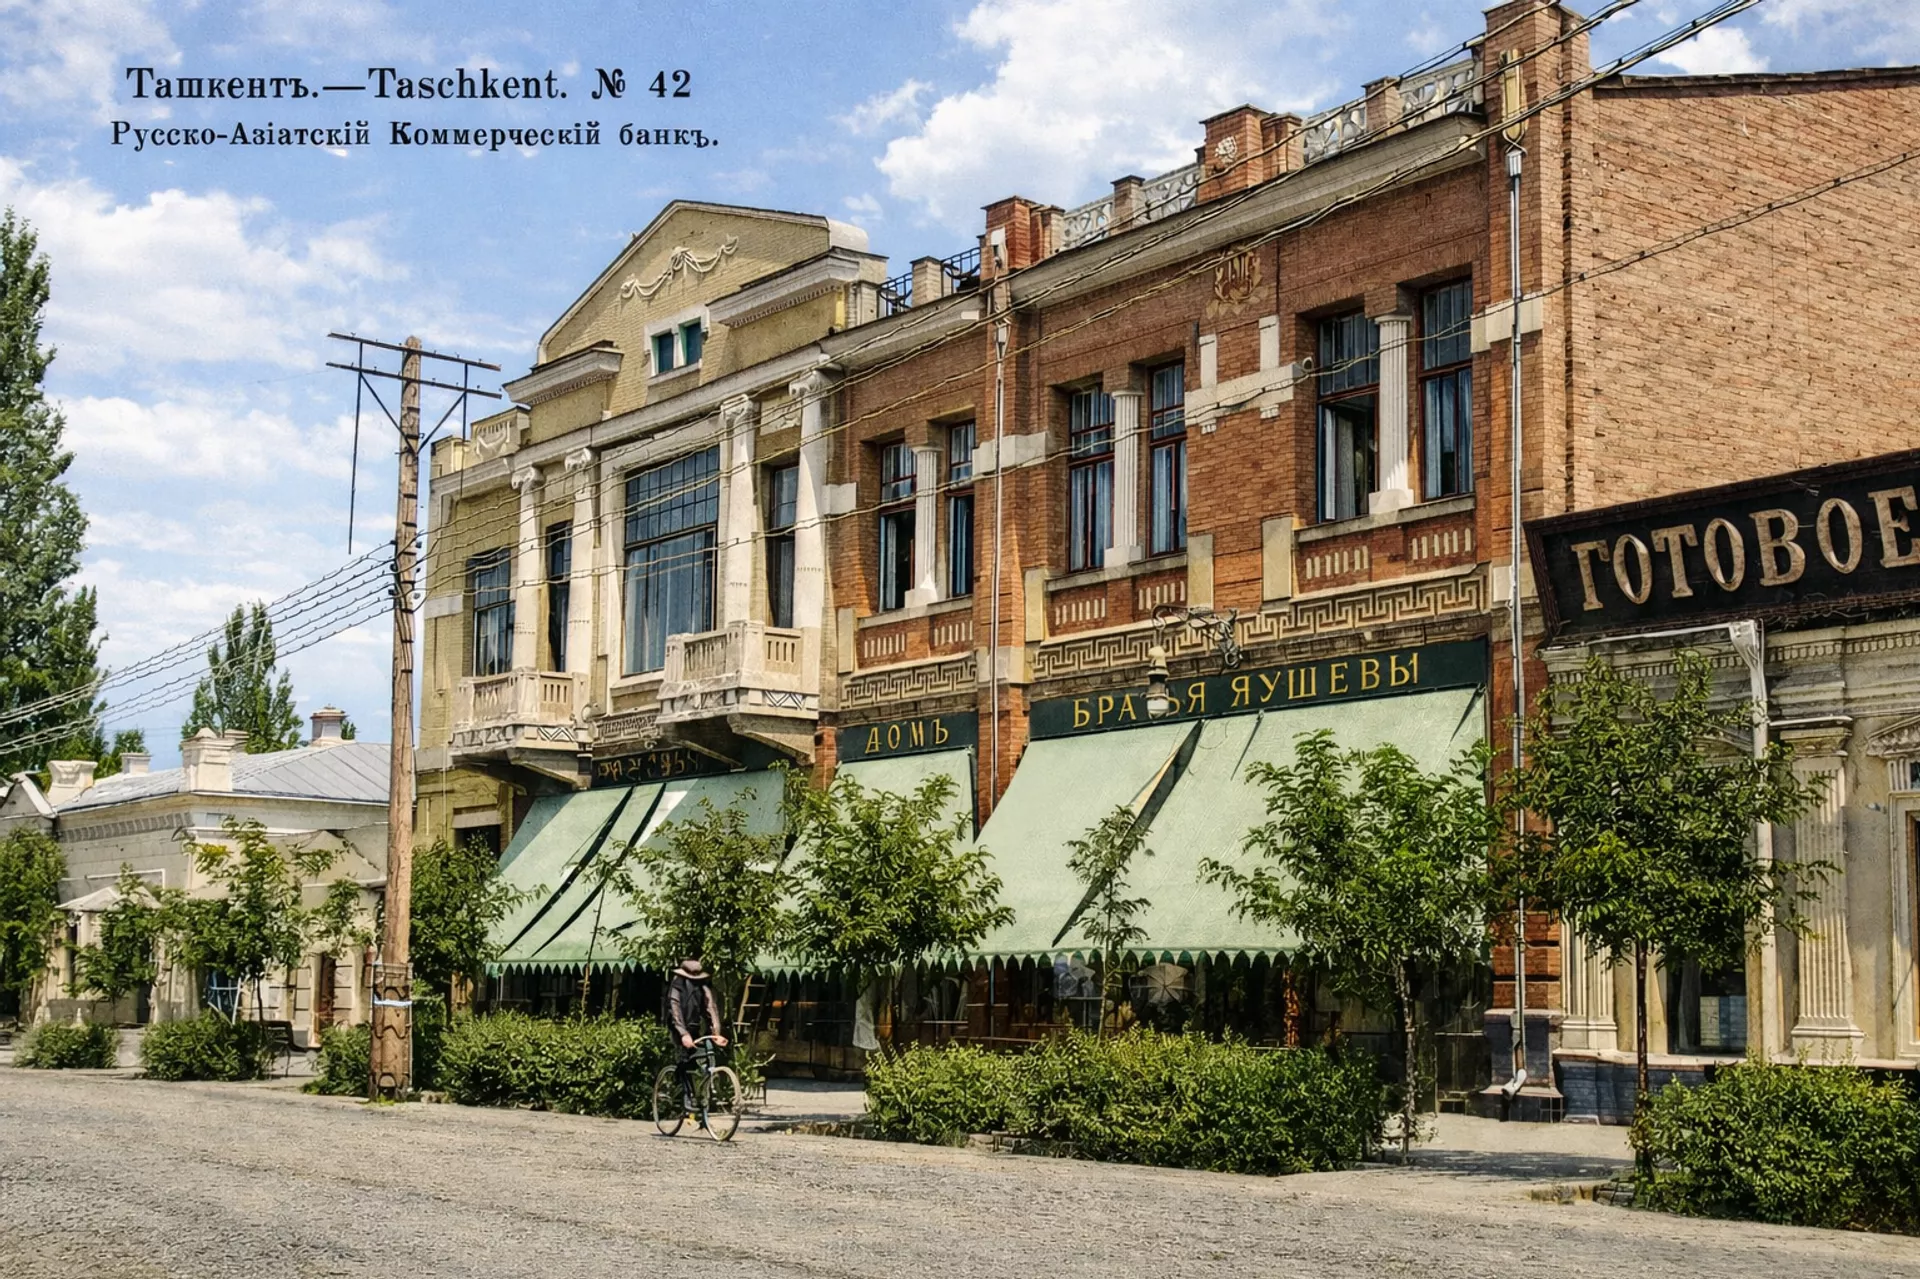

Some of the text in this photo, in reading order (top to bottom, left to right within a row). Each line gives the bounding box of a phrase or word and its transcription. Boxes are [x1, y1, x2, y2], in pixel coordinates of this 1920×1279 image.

[1570, 485, 1920, 611] ГОТОВОЕ
[1073, 651, 1419, 728] БРАЬЯ ЯУШЕВЫ
